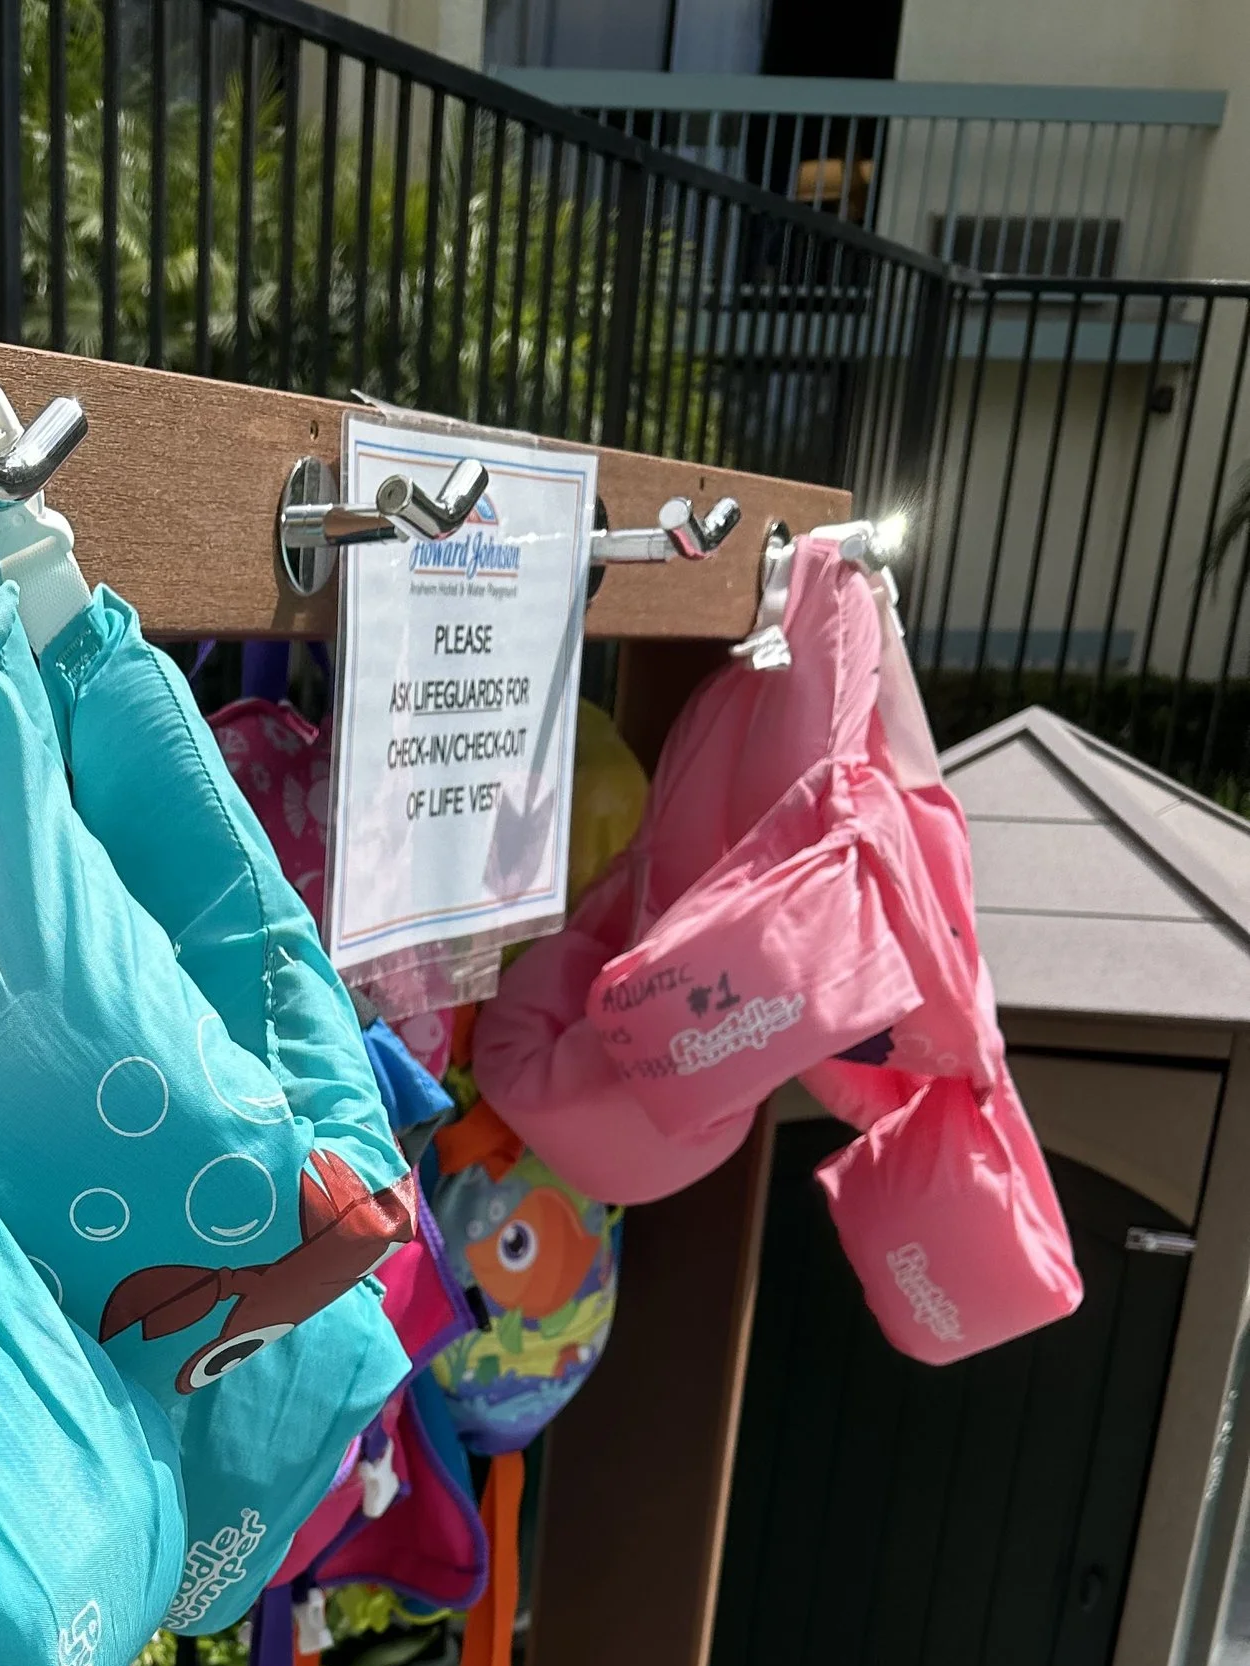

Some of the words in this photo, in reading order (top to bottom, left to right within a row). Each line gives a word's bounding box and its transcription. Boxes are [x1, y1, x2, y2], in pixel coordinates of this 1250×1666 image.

[465, 531, 520, 580] Johnson
[434, 625, 493, 655] PLEASE
[389, 681, 413, 713] ASK
[414, 677, 503, 712] LIFEGUARDS
[506, 676, 530, 706] FOR
[387, 728, 527, 770] CHECK-IN/CHECK-OUT
[406, 790, 425, 820] OF
[429, 786, 465, 817] LIFE
[469, 782, 502, 813] VEST
[602, 962, 694, 1014] AQUATIC
